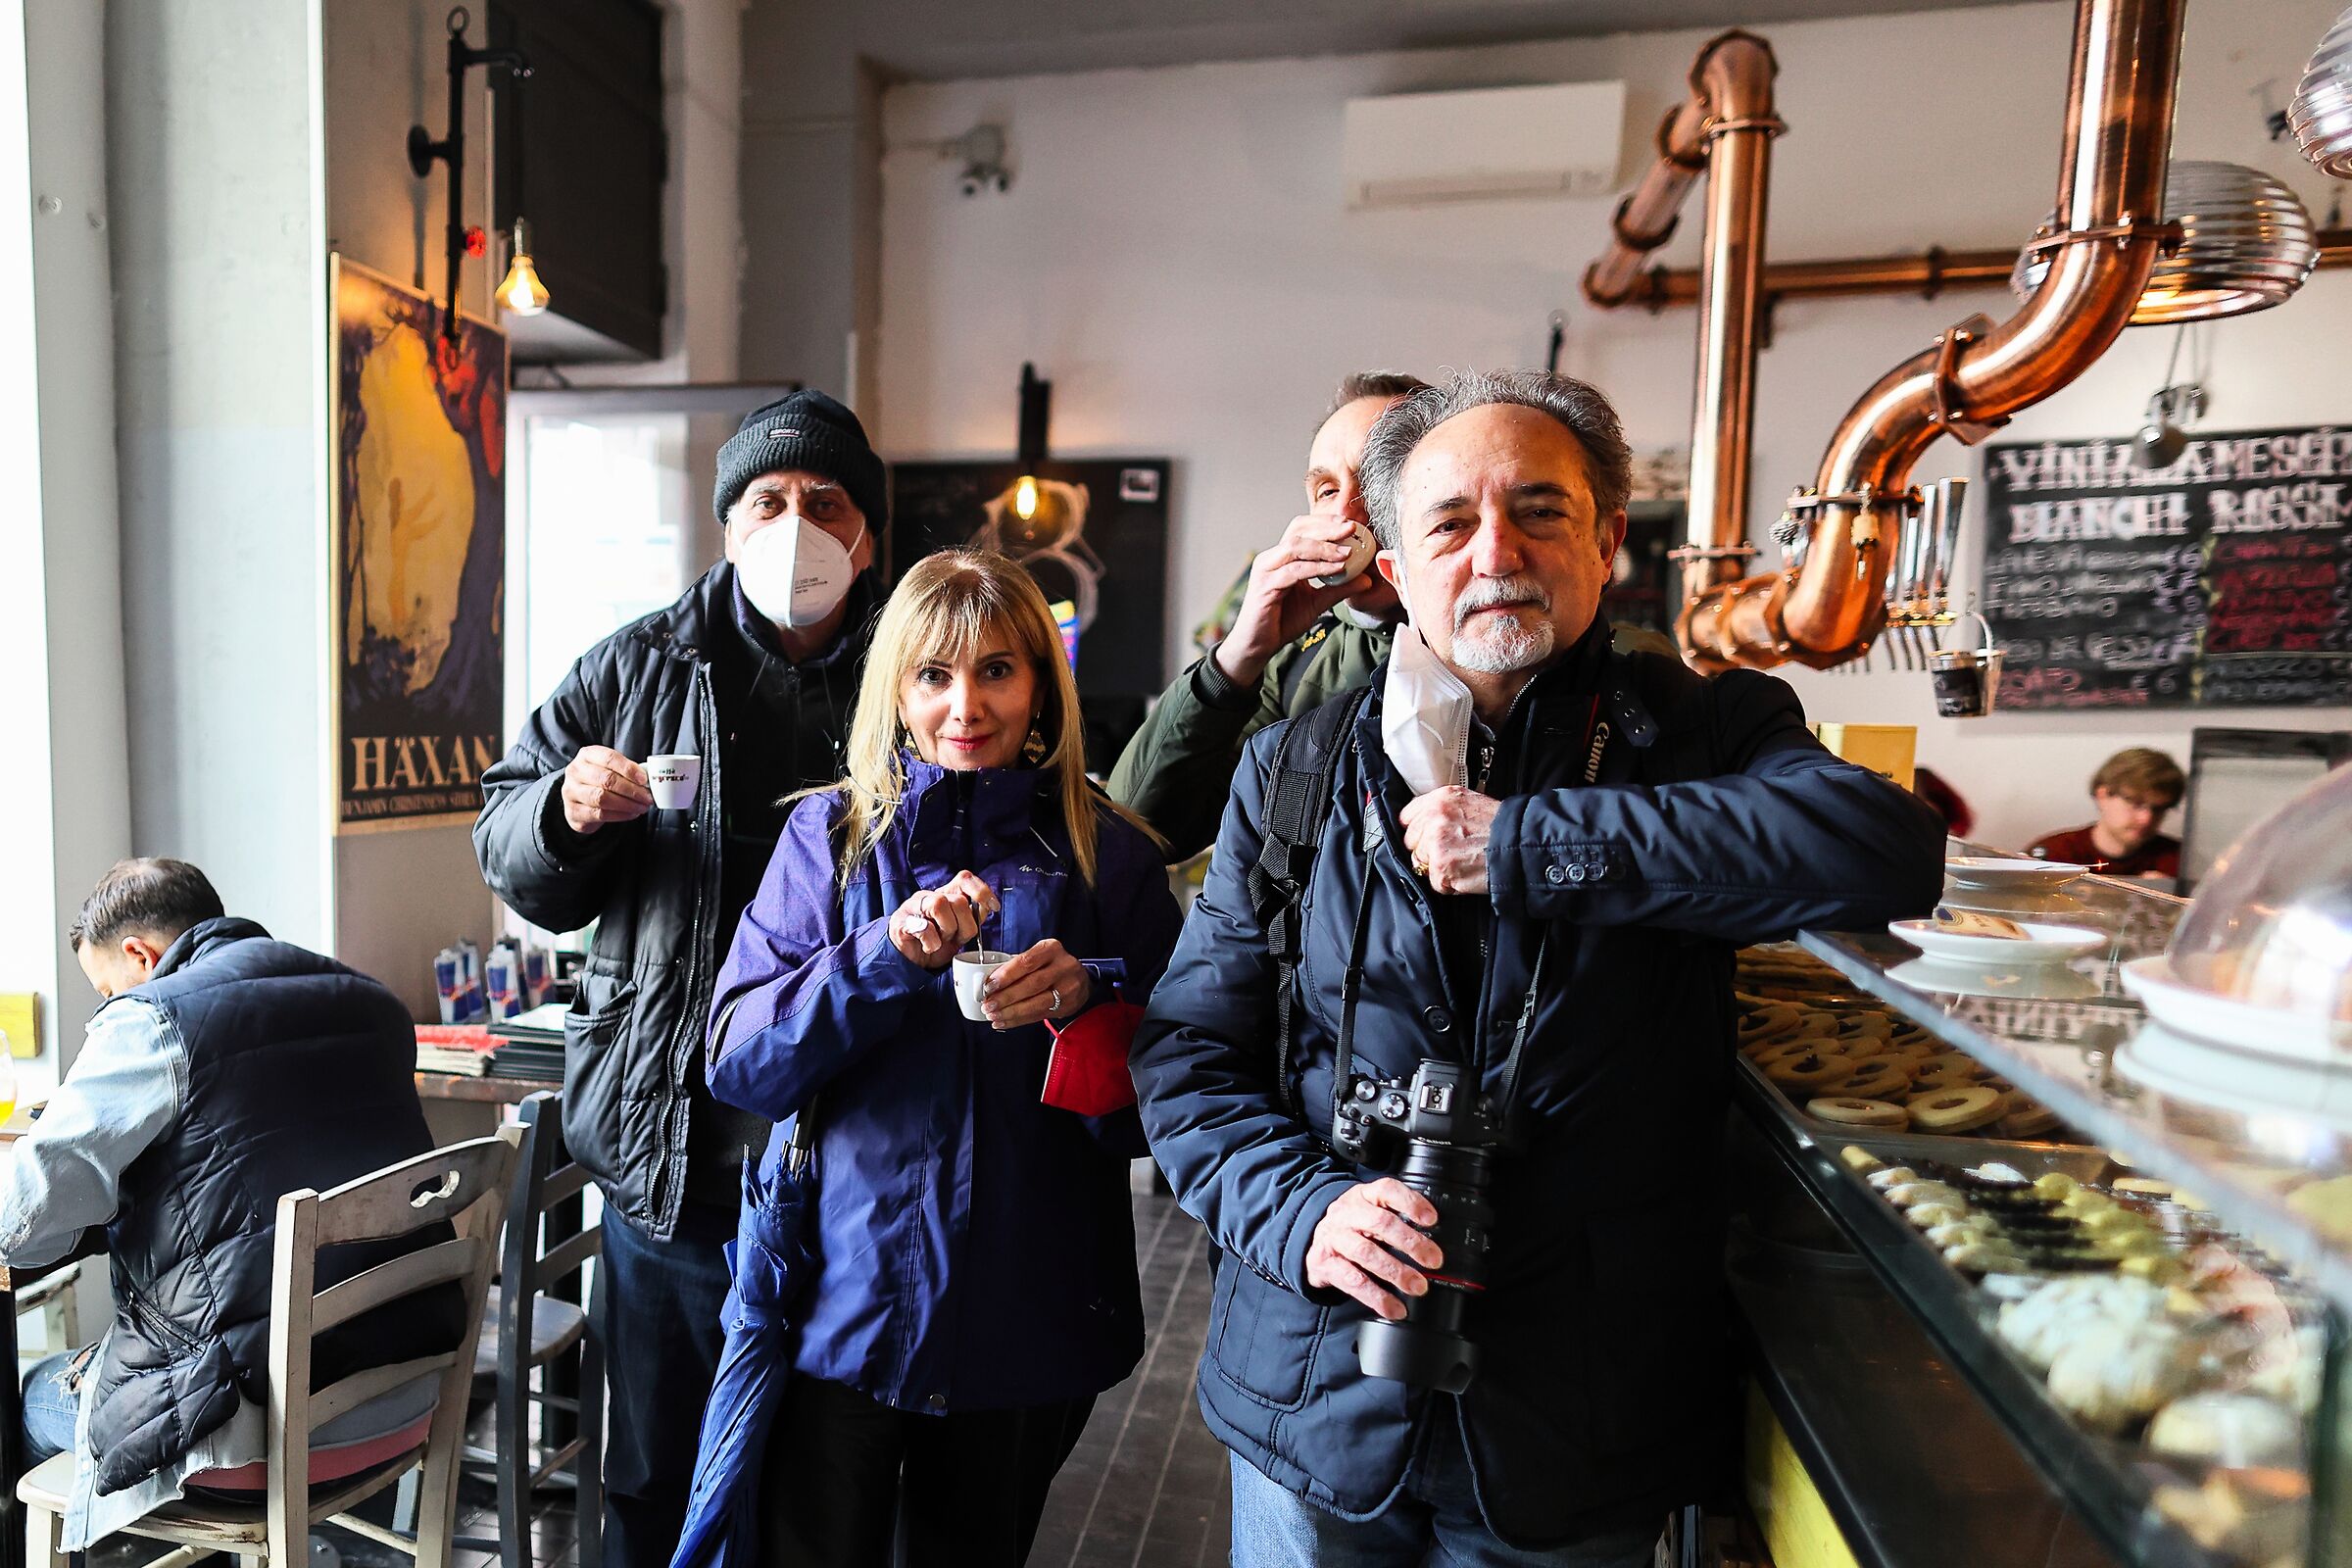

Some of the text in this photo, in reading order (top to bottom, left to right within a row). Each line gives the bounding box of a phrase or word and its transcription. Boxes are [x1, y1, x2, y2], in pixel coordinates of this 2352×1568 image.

[2008, 493, 2191, 545] BIANCHI
[351, 735, 495, 792] HÄXAN
[1584, 722, 1610, 783] Canon
[1417, 1136, 1452, 1146] Canon
